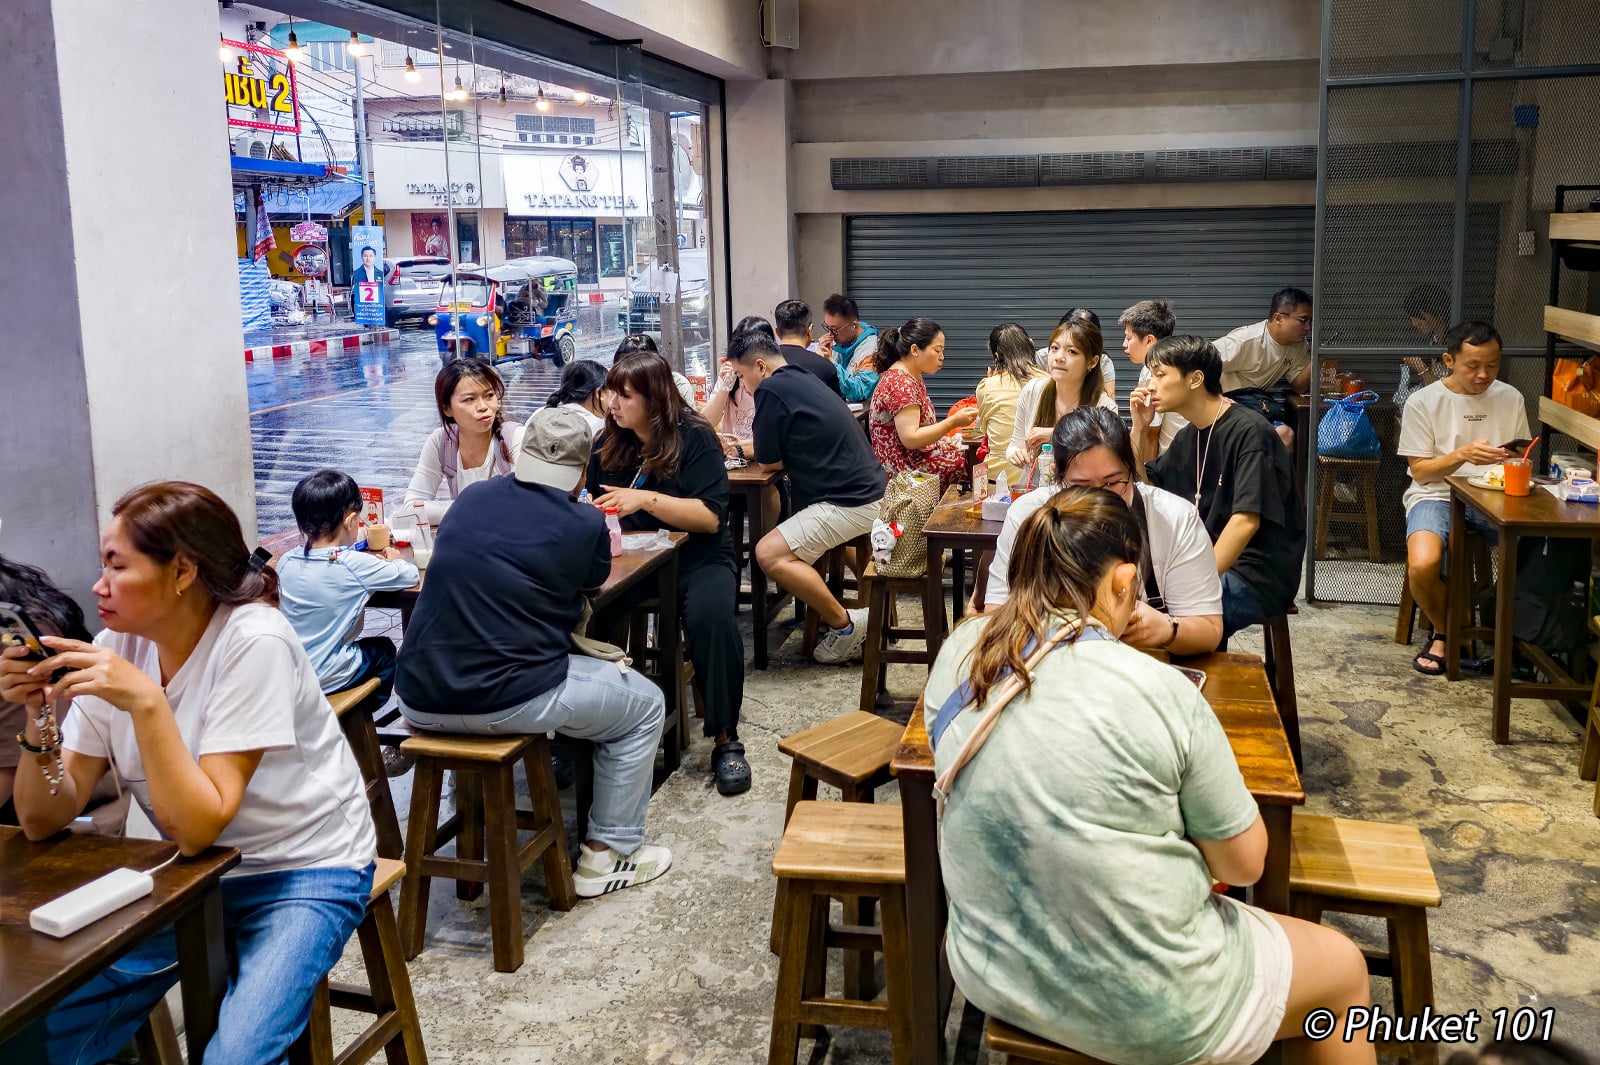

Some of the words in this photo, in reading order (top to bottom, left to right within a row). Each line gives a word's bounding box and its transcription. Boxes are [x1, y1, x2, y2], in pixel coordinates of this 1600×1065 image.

[270, 73, 292, 113] 2
[432, 195, 461, 206] TEA
[524, 194, 598, 208] TATANG
[599, 194, 639, 208] TEA
[364, 287, 375, 302] 2
[664, 293, 671, 302] 2
